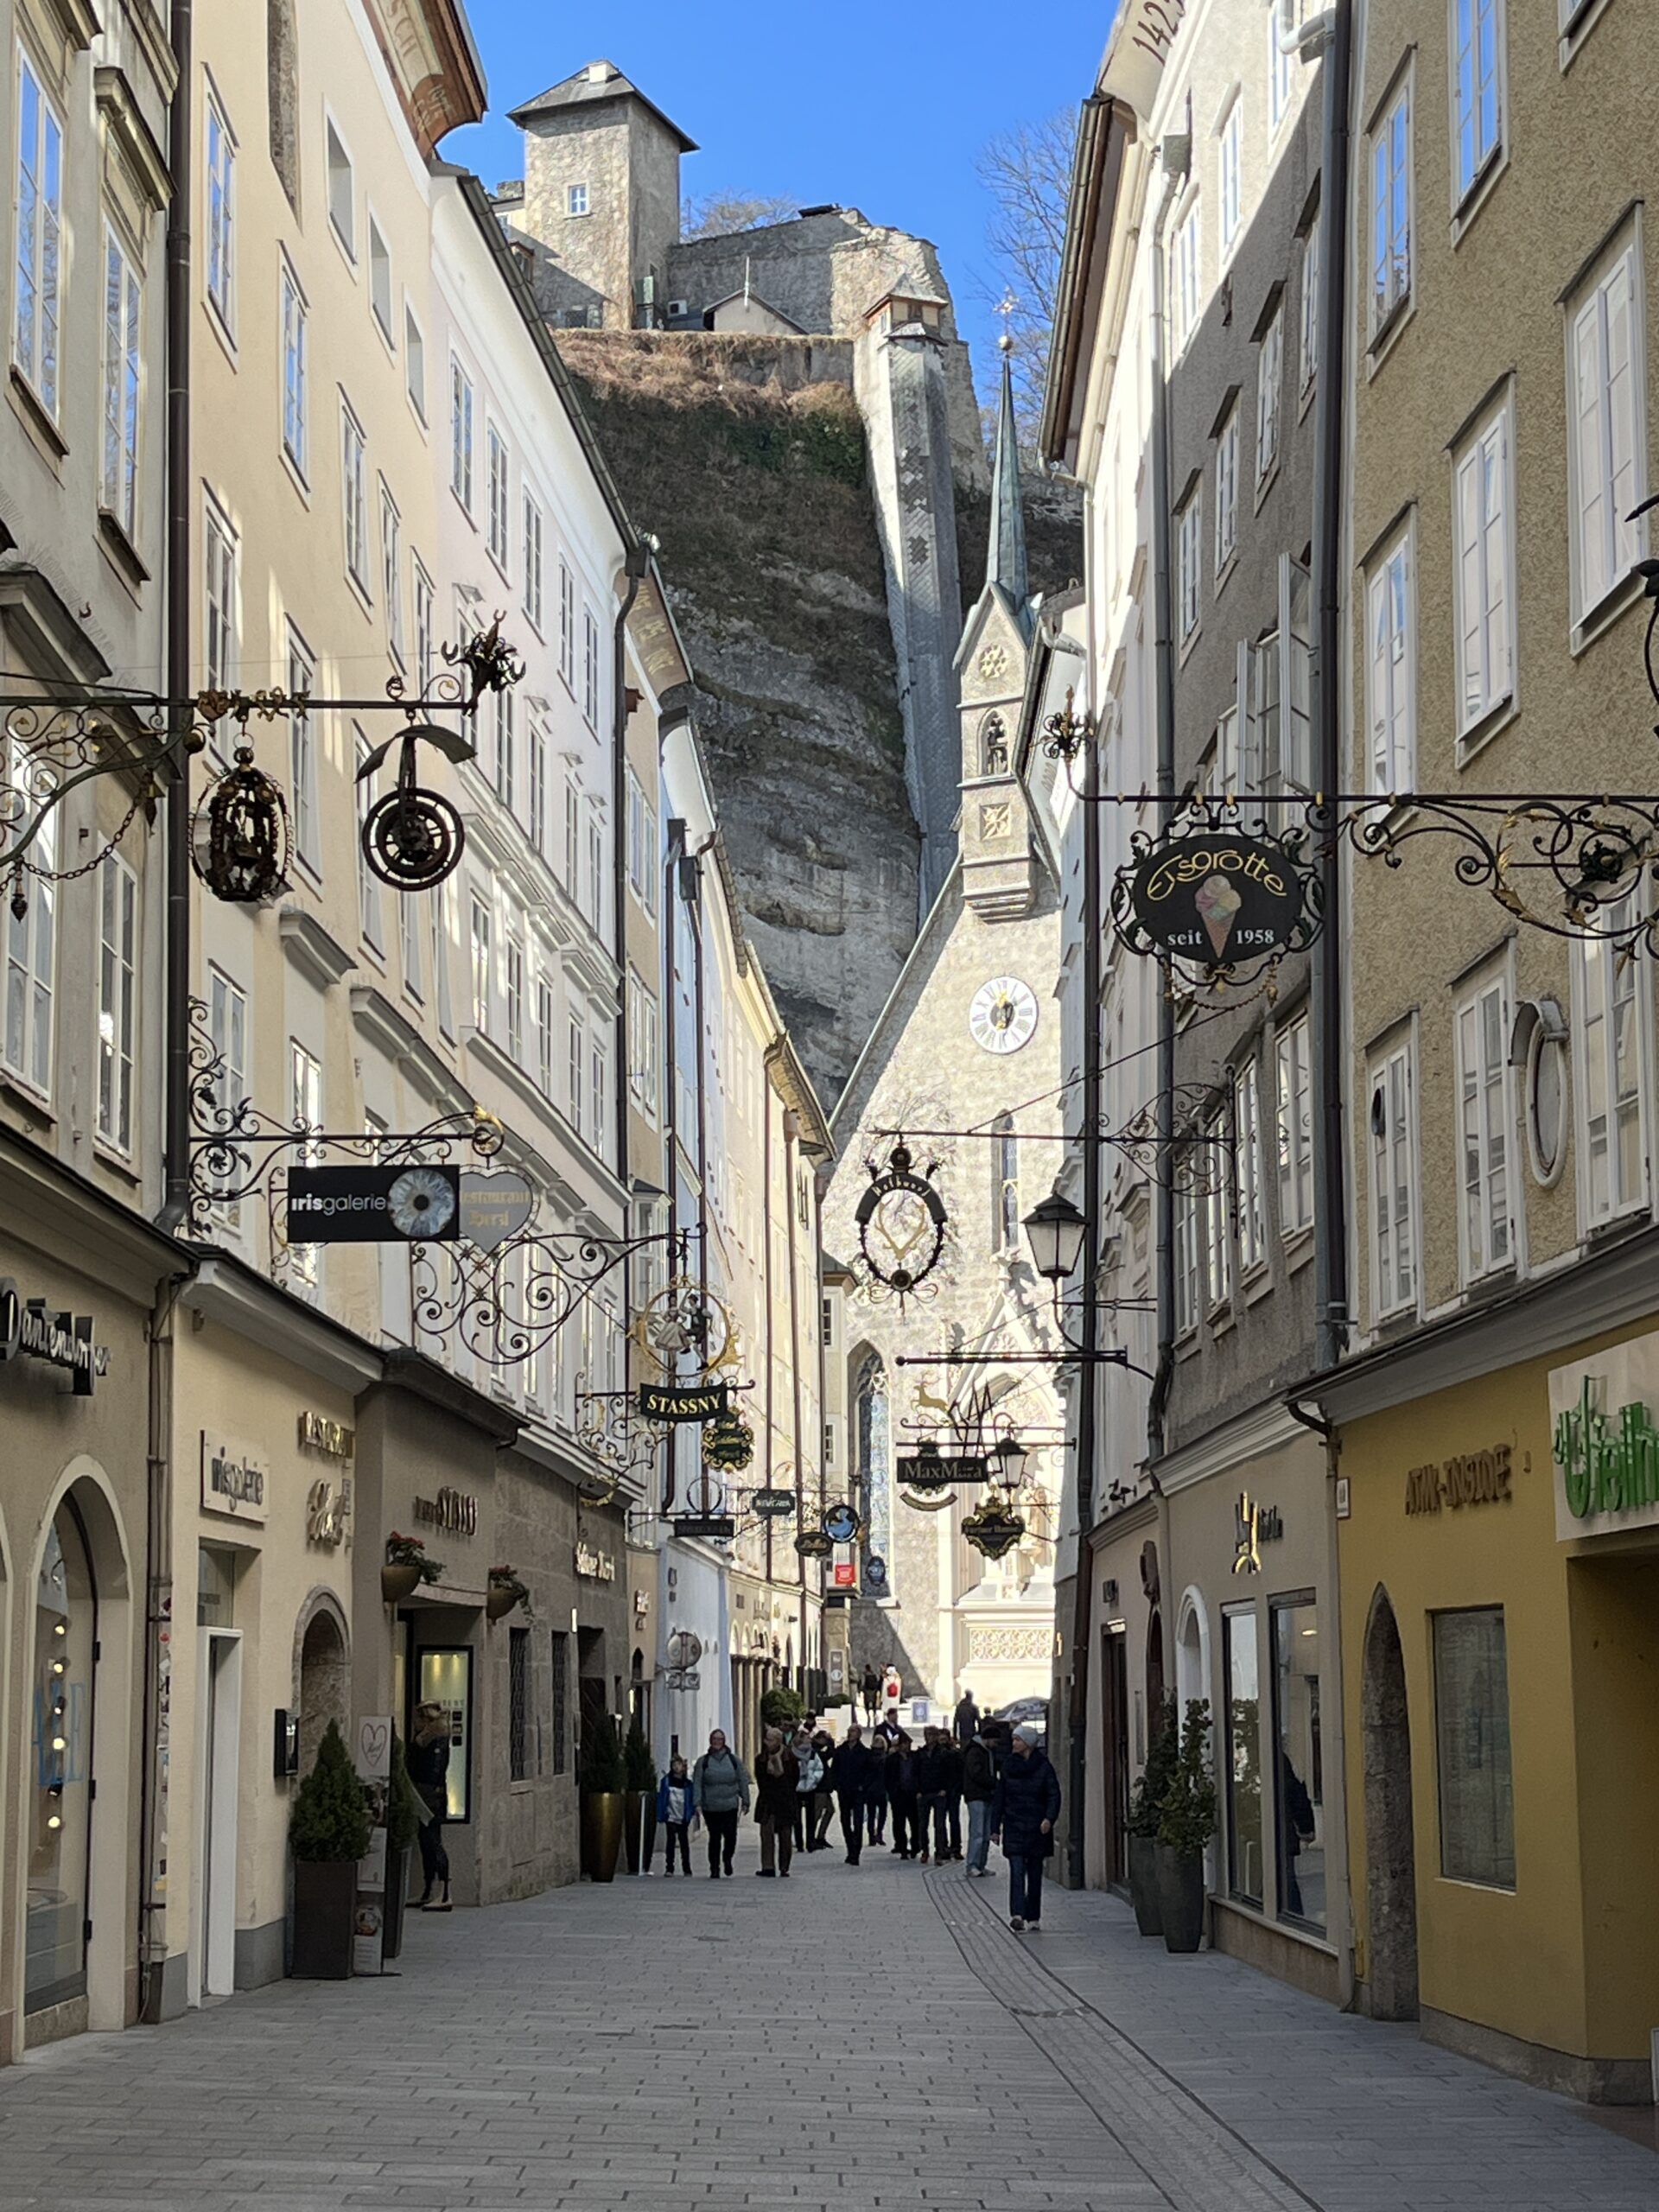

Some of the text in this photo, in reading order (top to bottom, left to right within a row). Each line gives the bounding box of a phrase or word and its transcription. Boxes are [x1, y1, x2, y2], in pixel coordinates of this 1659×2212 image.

[1168, 929, 1275, 945] seit 1958
[292, 1193, 386, 1216] irisgalerie
[647, 1394, 721, 1414] STASSNY
